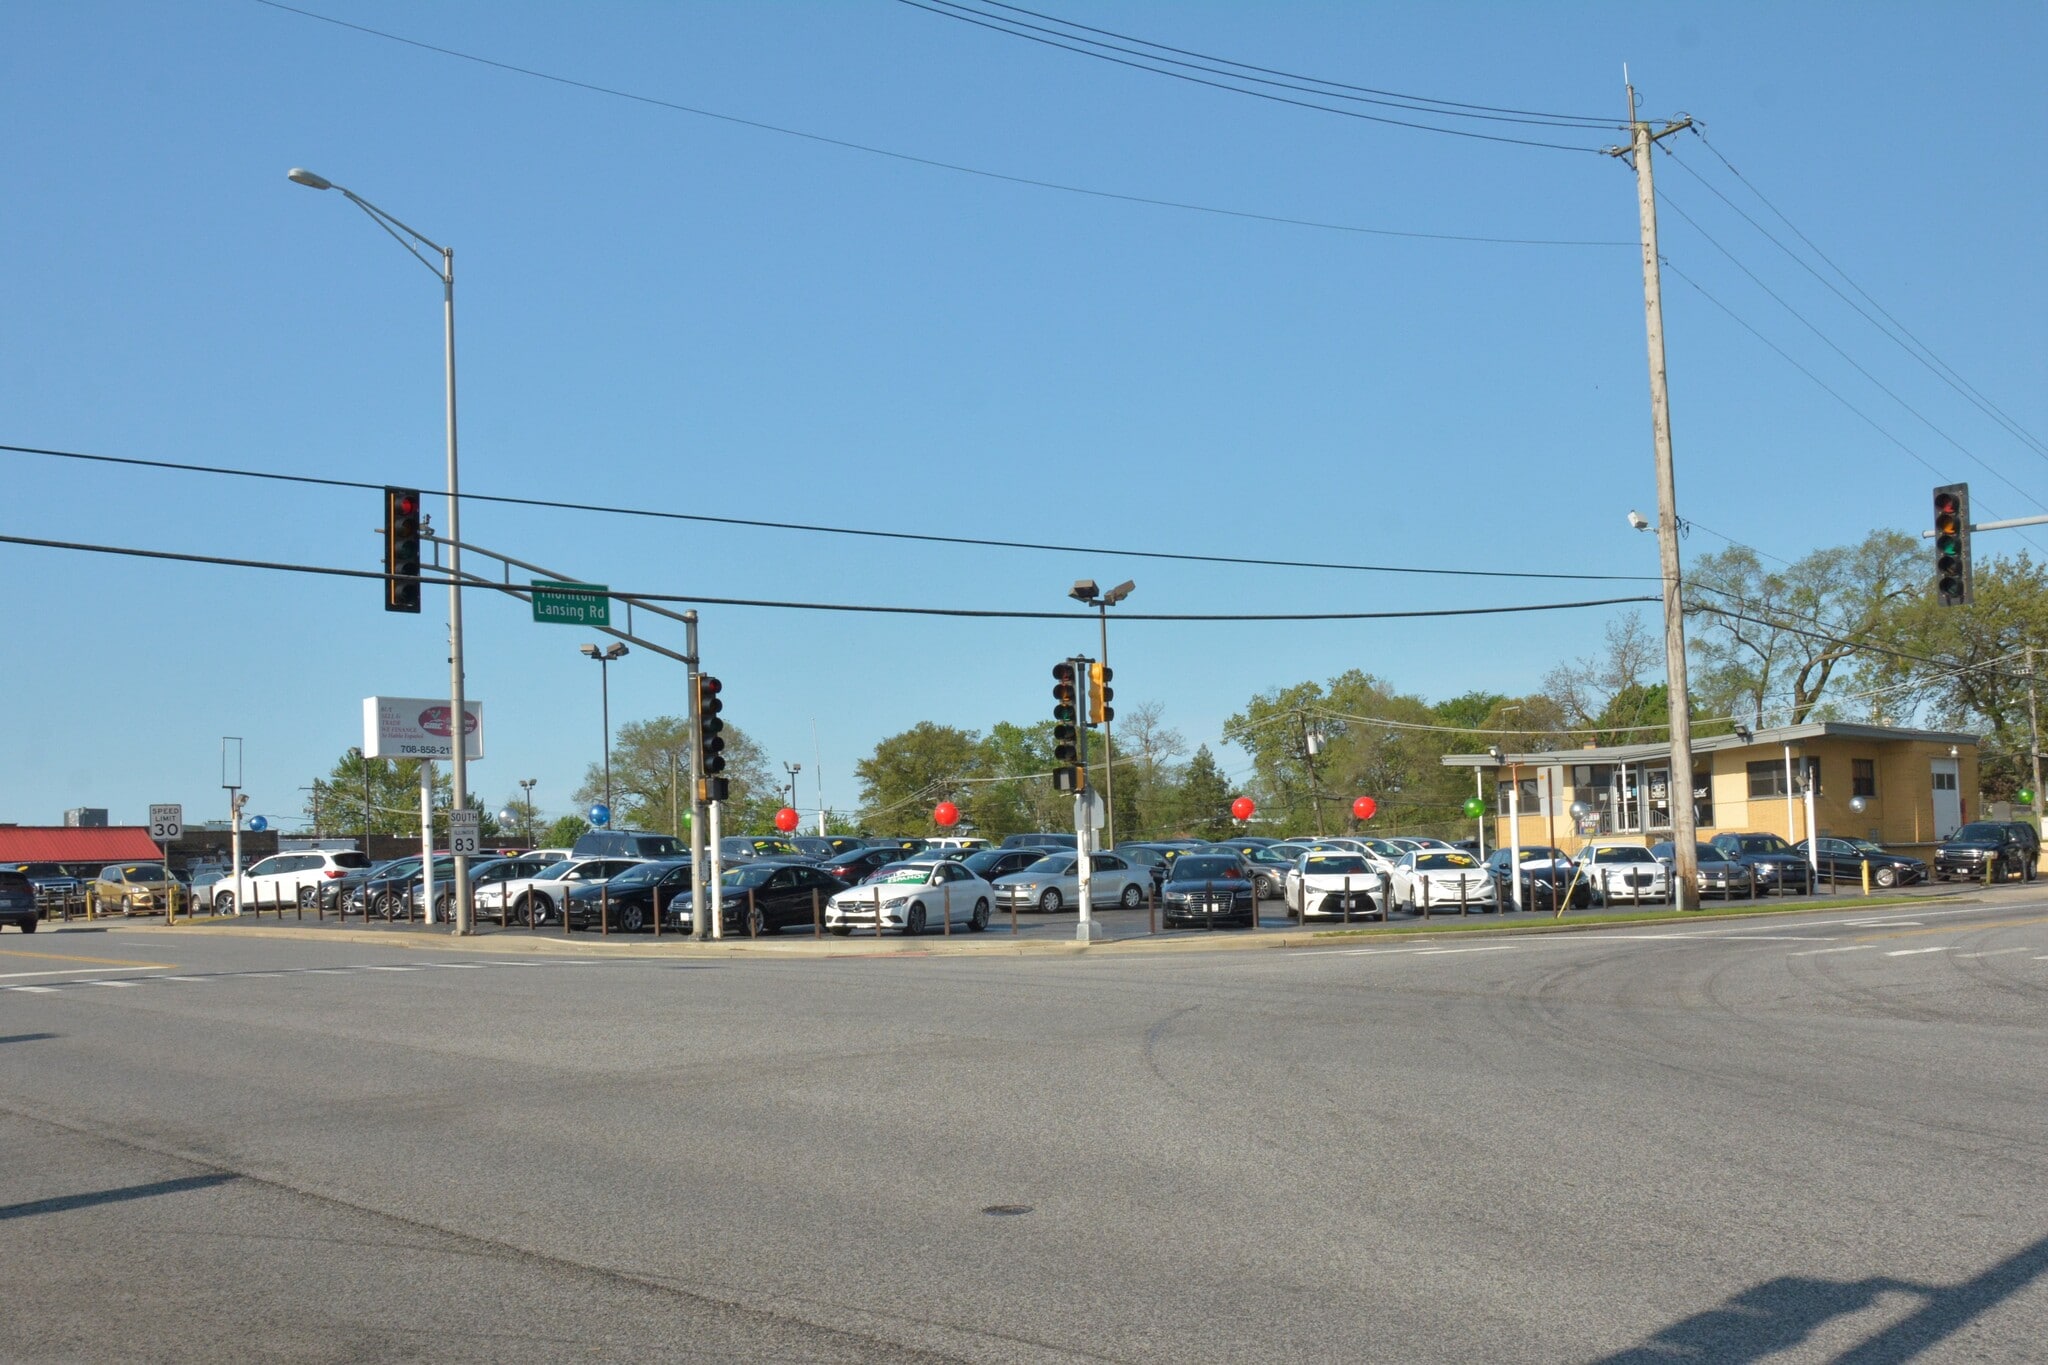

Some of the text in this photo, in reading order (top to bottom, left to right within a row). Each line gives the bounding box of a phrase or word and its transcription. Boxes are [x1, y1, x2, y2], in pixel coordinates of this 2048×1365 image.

[538, 601, 605, 621] Lansing Rd
[401, 745, 453, 755] 708-858-21
[451, 813, 477, 822] SOUTH
[154, 823, 179, 836] 30
[455, 838, 475, 852] 83
